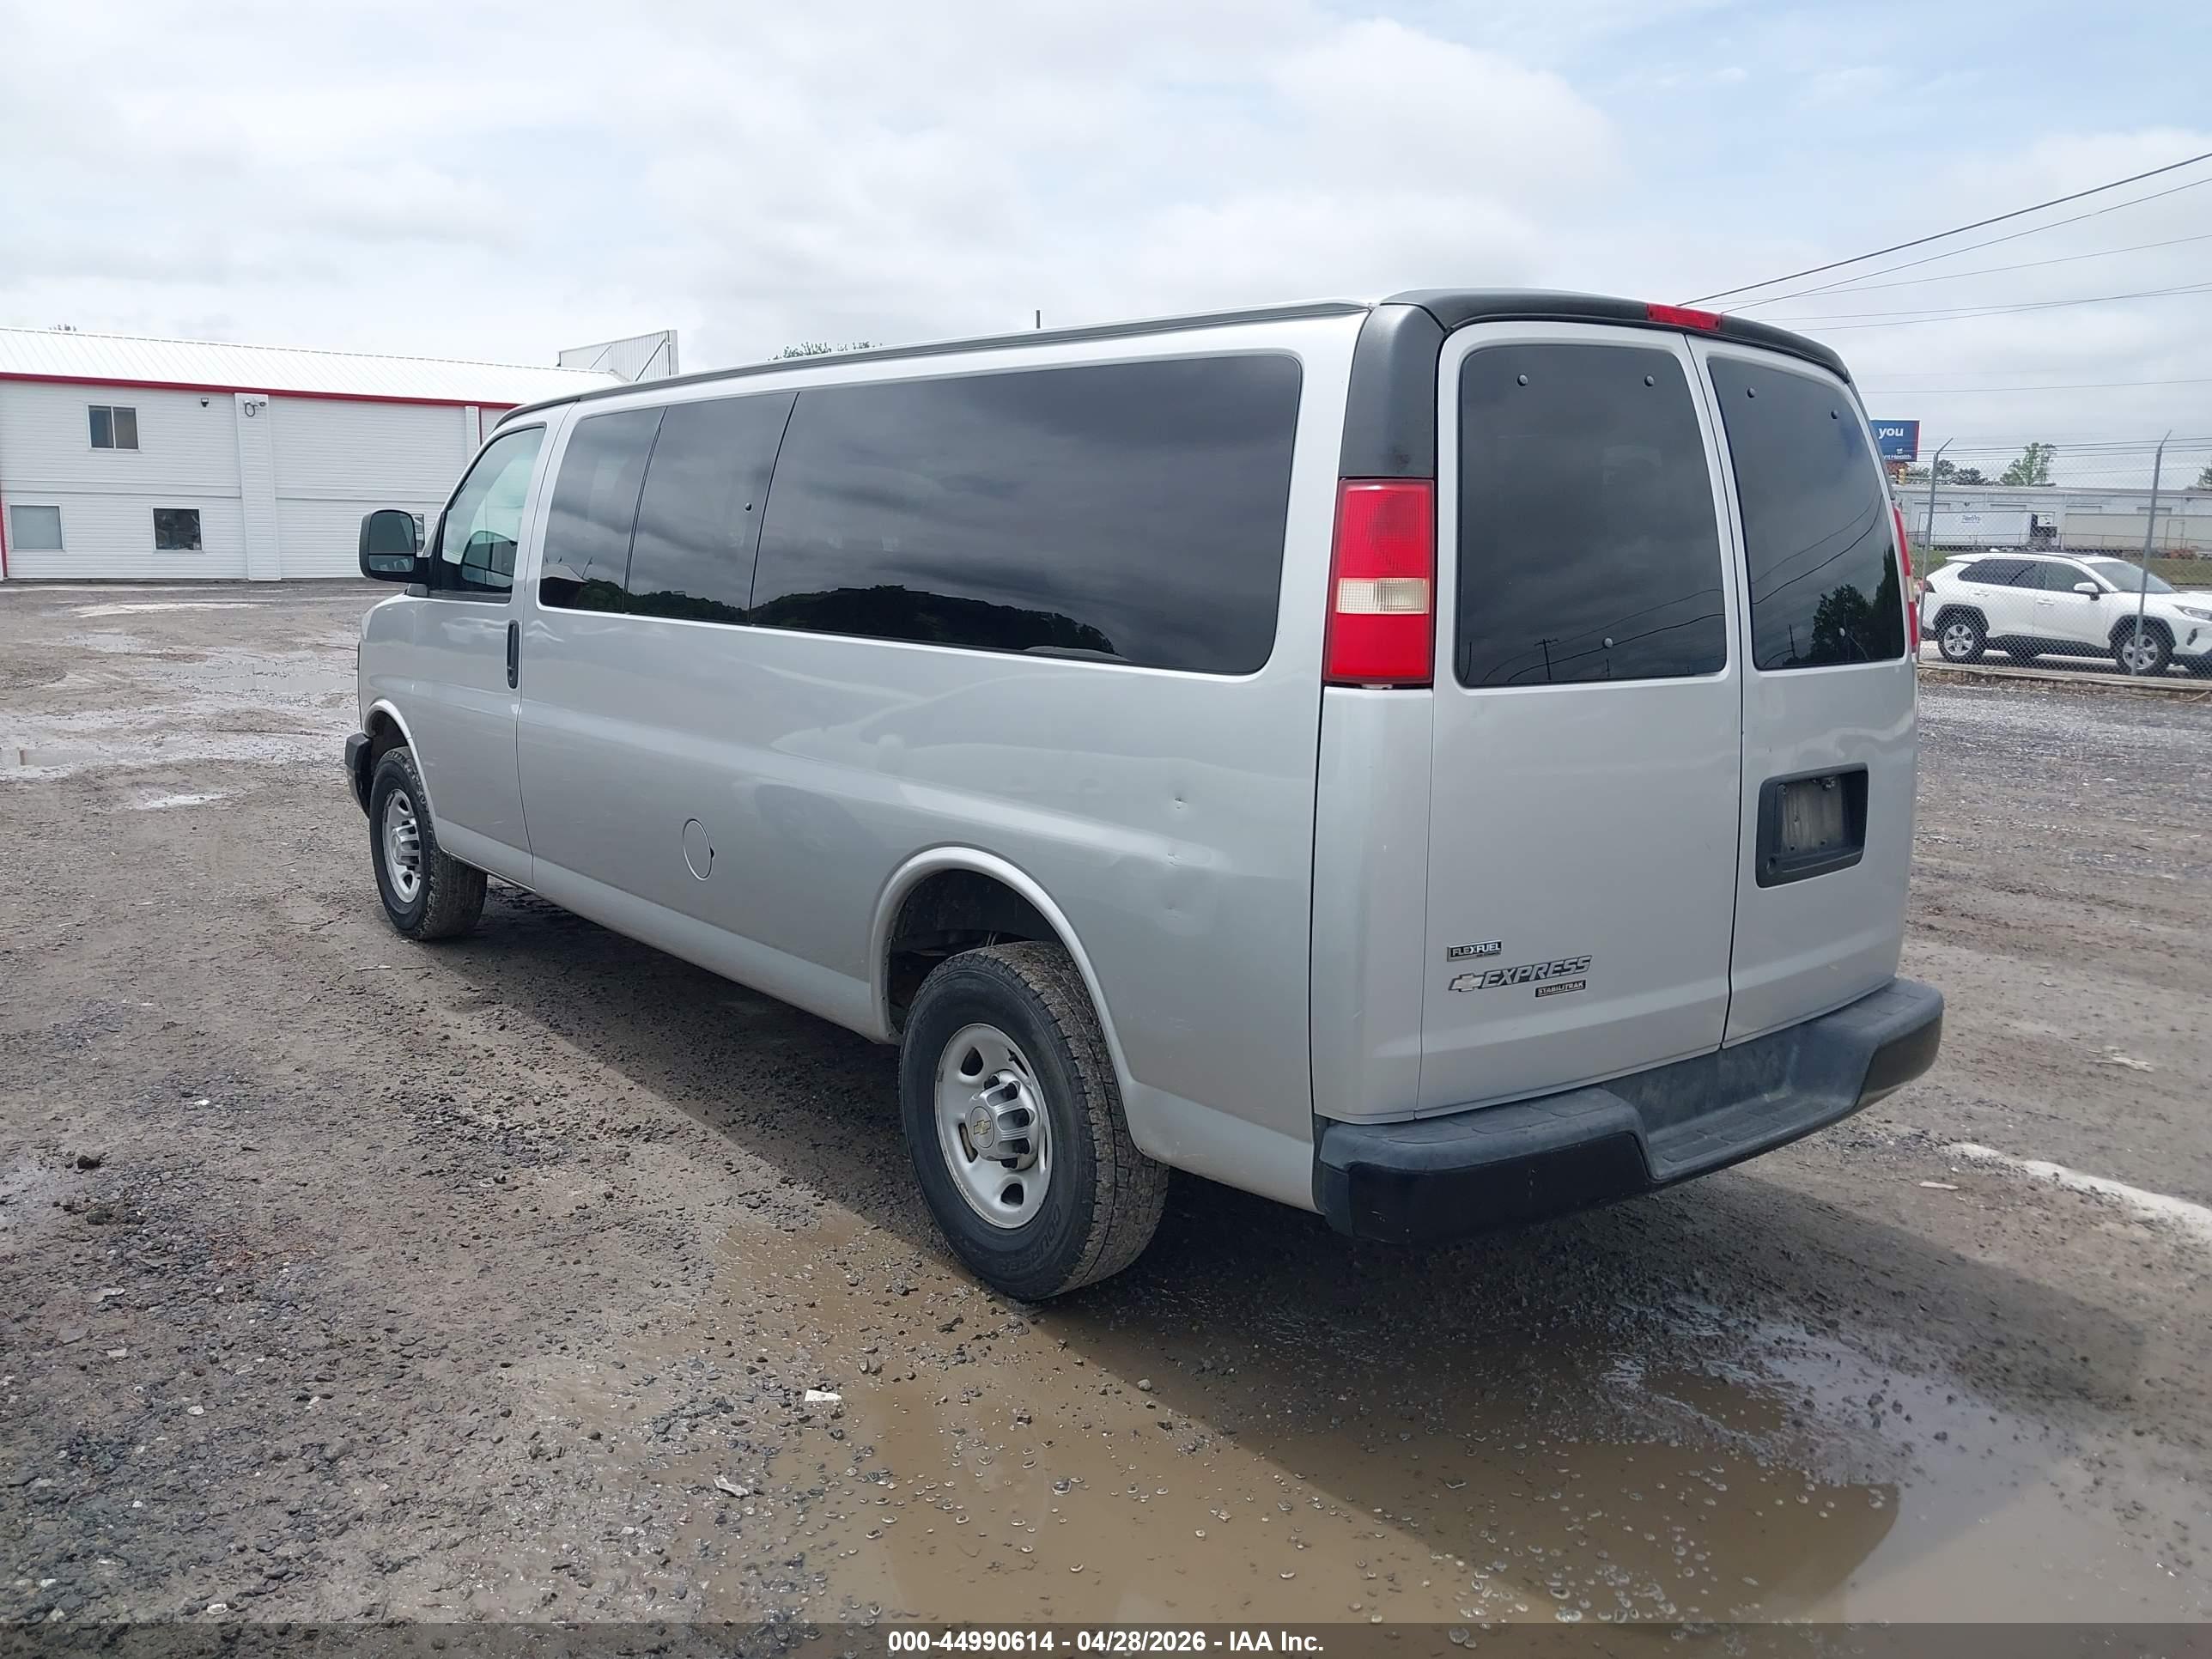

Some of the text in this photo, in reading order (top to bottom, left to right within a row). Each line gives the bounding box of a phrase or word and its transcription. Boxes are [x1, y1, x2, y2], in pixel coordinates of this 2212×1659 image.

[1878, 428, 1904, 440] you
[1480, 955, 1593, 989] EXPRESS
[1537, 981, 1584, 994] STABILITRAK
